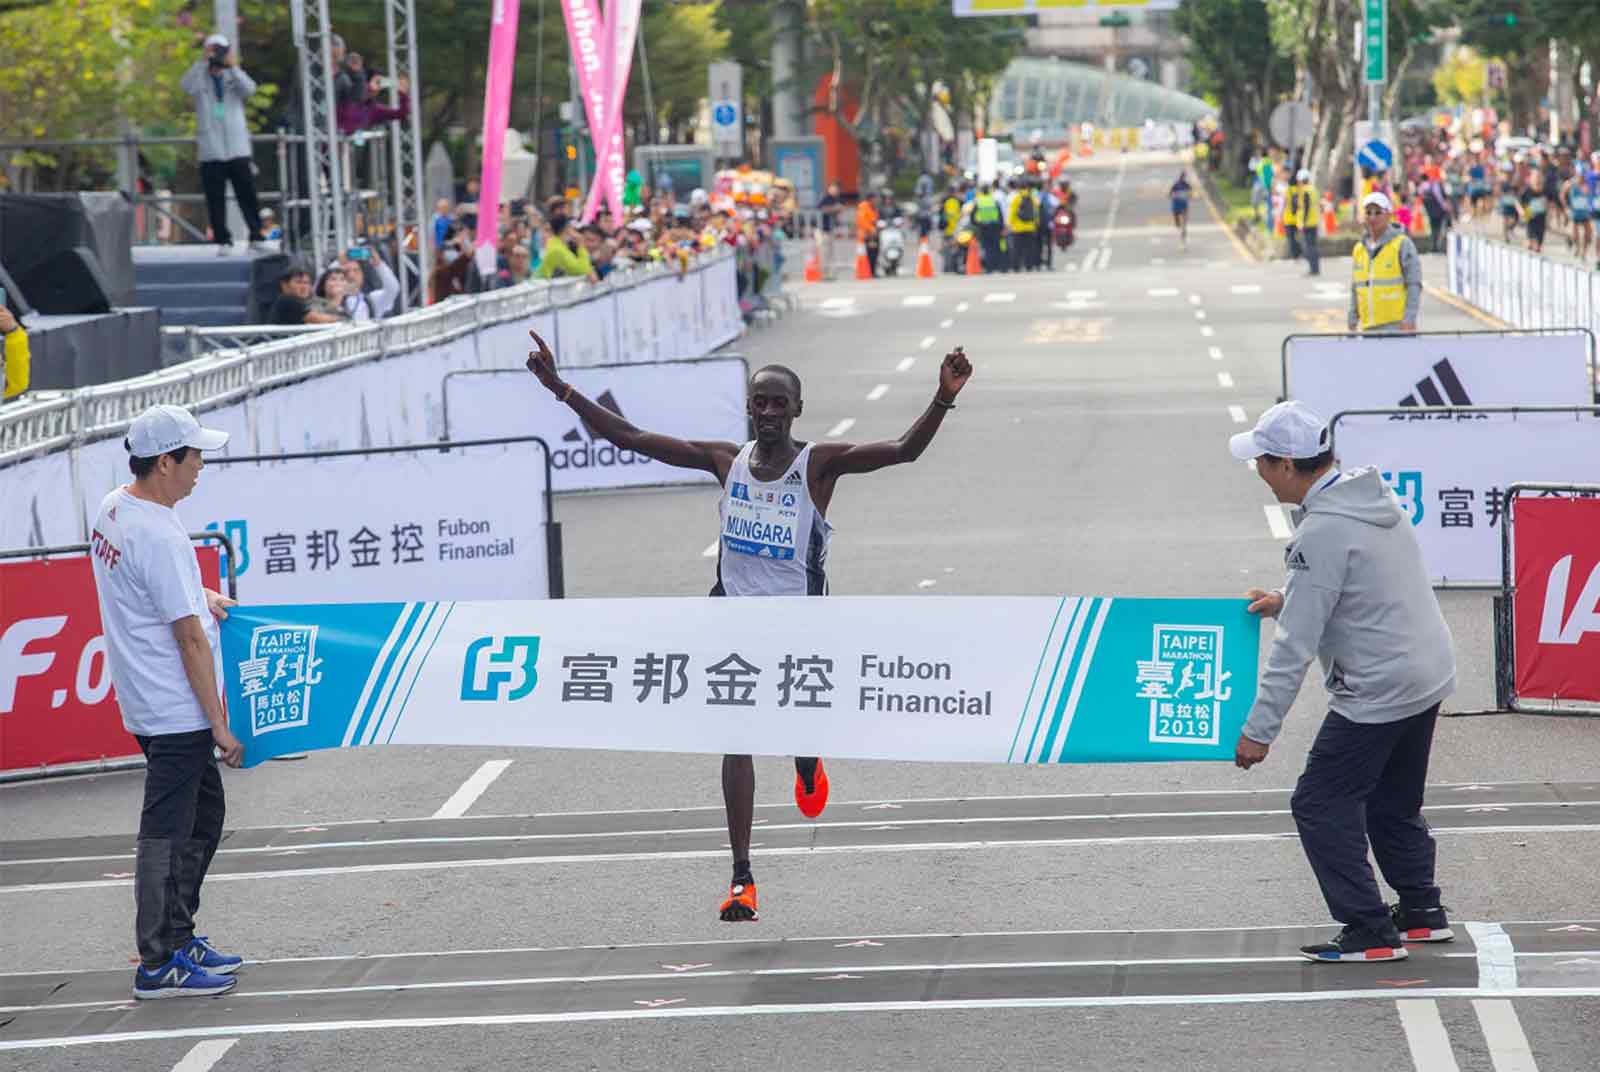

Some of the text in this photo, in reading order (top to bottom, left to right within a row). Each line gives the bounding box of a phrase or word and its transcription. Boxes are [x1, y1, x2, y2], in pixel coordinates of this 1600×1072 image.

[438, 519, 490, 537] Fubon
[726, 515, 793, 544] MUNGARA
[263, 523, 424, 575] 富邦金控
[439, 538, 515, 560] Financial
[261, 632, 308, 647] TAIPEI
[1162, 634, 1214, 651] TAIPEI
[1162, 652, 1214, 660] MARATHON
[859, 653, 951, 681] Fubon
[561, 651, 835, 709] 富邦金控
[858, 686, 992, 716] Financial
[1160, 703, 1210, 720] 馬拉松
[257, 705, 300, 726] 2019
[1159, 720, 1209, 736] 2019
